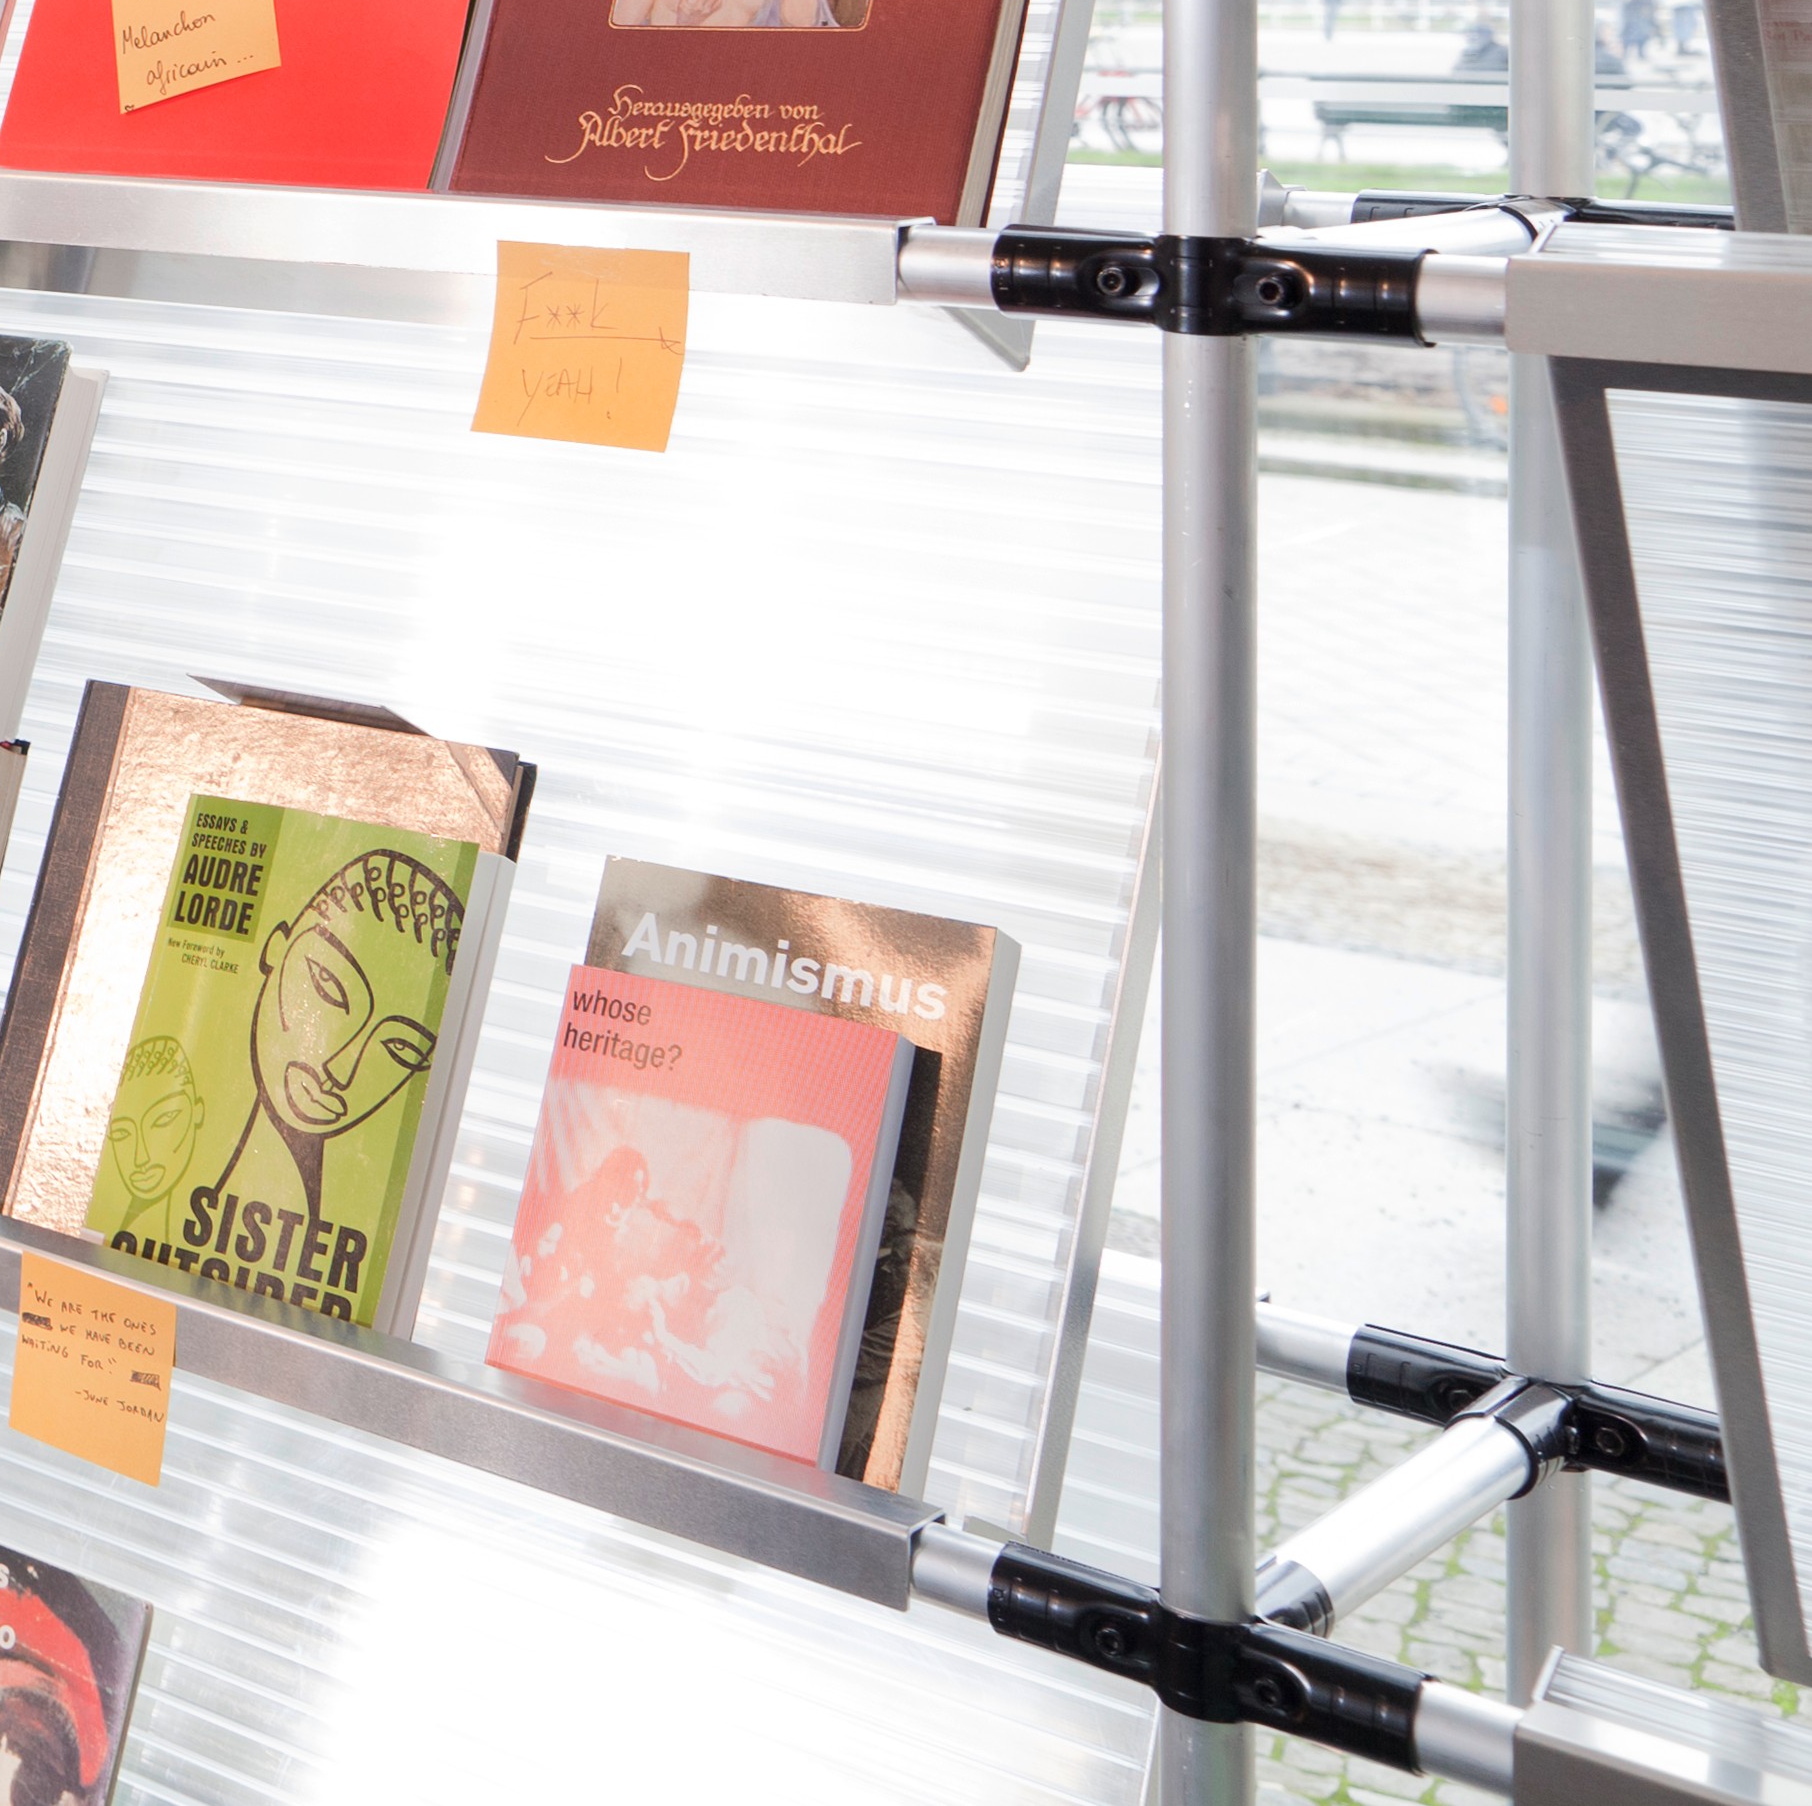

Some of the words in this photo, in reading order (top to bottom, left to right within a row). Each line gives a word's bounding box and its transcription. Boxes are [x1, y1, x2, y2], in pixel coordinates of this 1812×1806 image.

[608, 84, 776, 128] Herausgegeben
[779, 101, 825, 121] von
[544, 110, 671, 163] Albert
[644, 117, 863, 182] Friedenthal
[196, 812, 238, 833] ESSAYS
[239, 819, 249, 835] &
[191, 833, 247, 856] SPEECHES
[250, 842, 267, 859] BY
[183, 853, 264, 897] AUDRE
[174, 891, 254, 935] LORDE
[167, 937, 181, 948] New
[182, 939, 215, 956] Foreword
[215, 947, 226, 958] by
[181, 953, 208, 968] CHERYL
[210, 959, 239, 974] CLARKE
[622, 911, 950, 1021] Animismus
[572, 990, 653, 1026] whose
[563, 1022, 684, 1072] heritage?
[182, 1185, 368, 1294] SISTER
[61, 1301, 82, 1315] ARE
[91, 1309, 116, 1324] THE
[123, 1317, 156, 1336] ONES
[60, 1324, 77, 1335] WE
[85, 1329, 111, 1344] HAVE
[118, 1338, 155, 1356] BEEN
[116, 1400, 165, 1423] JORDAN
